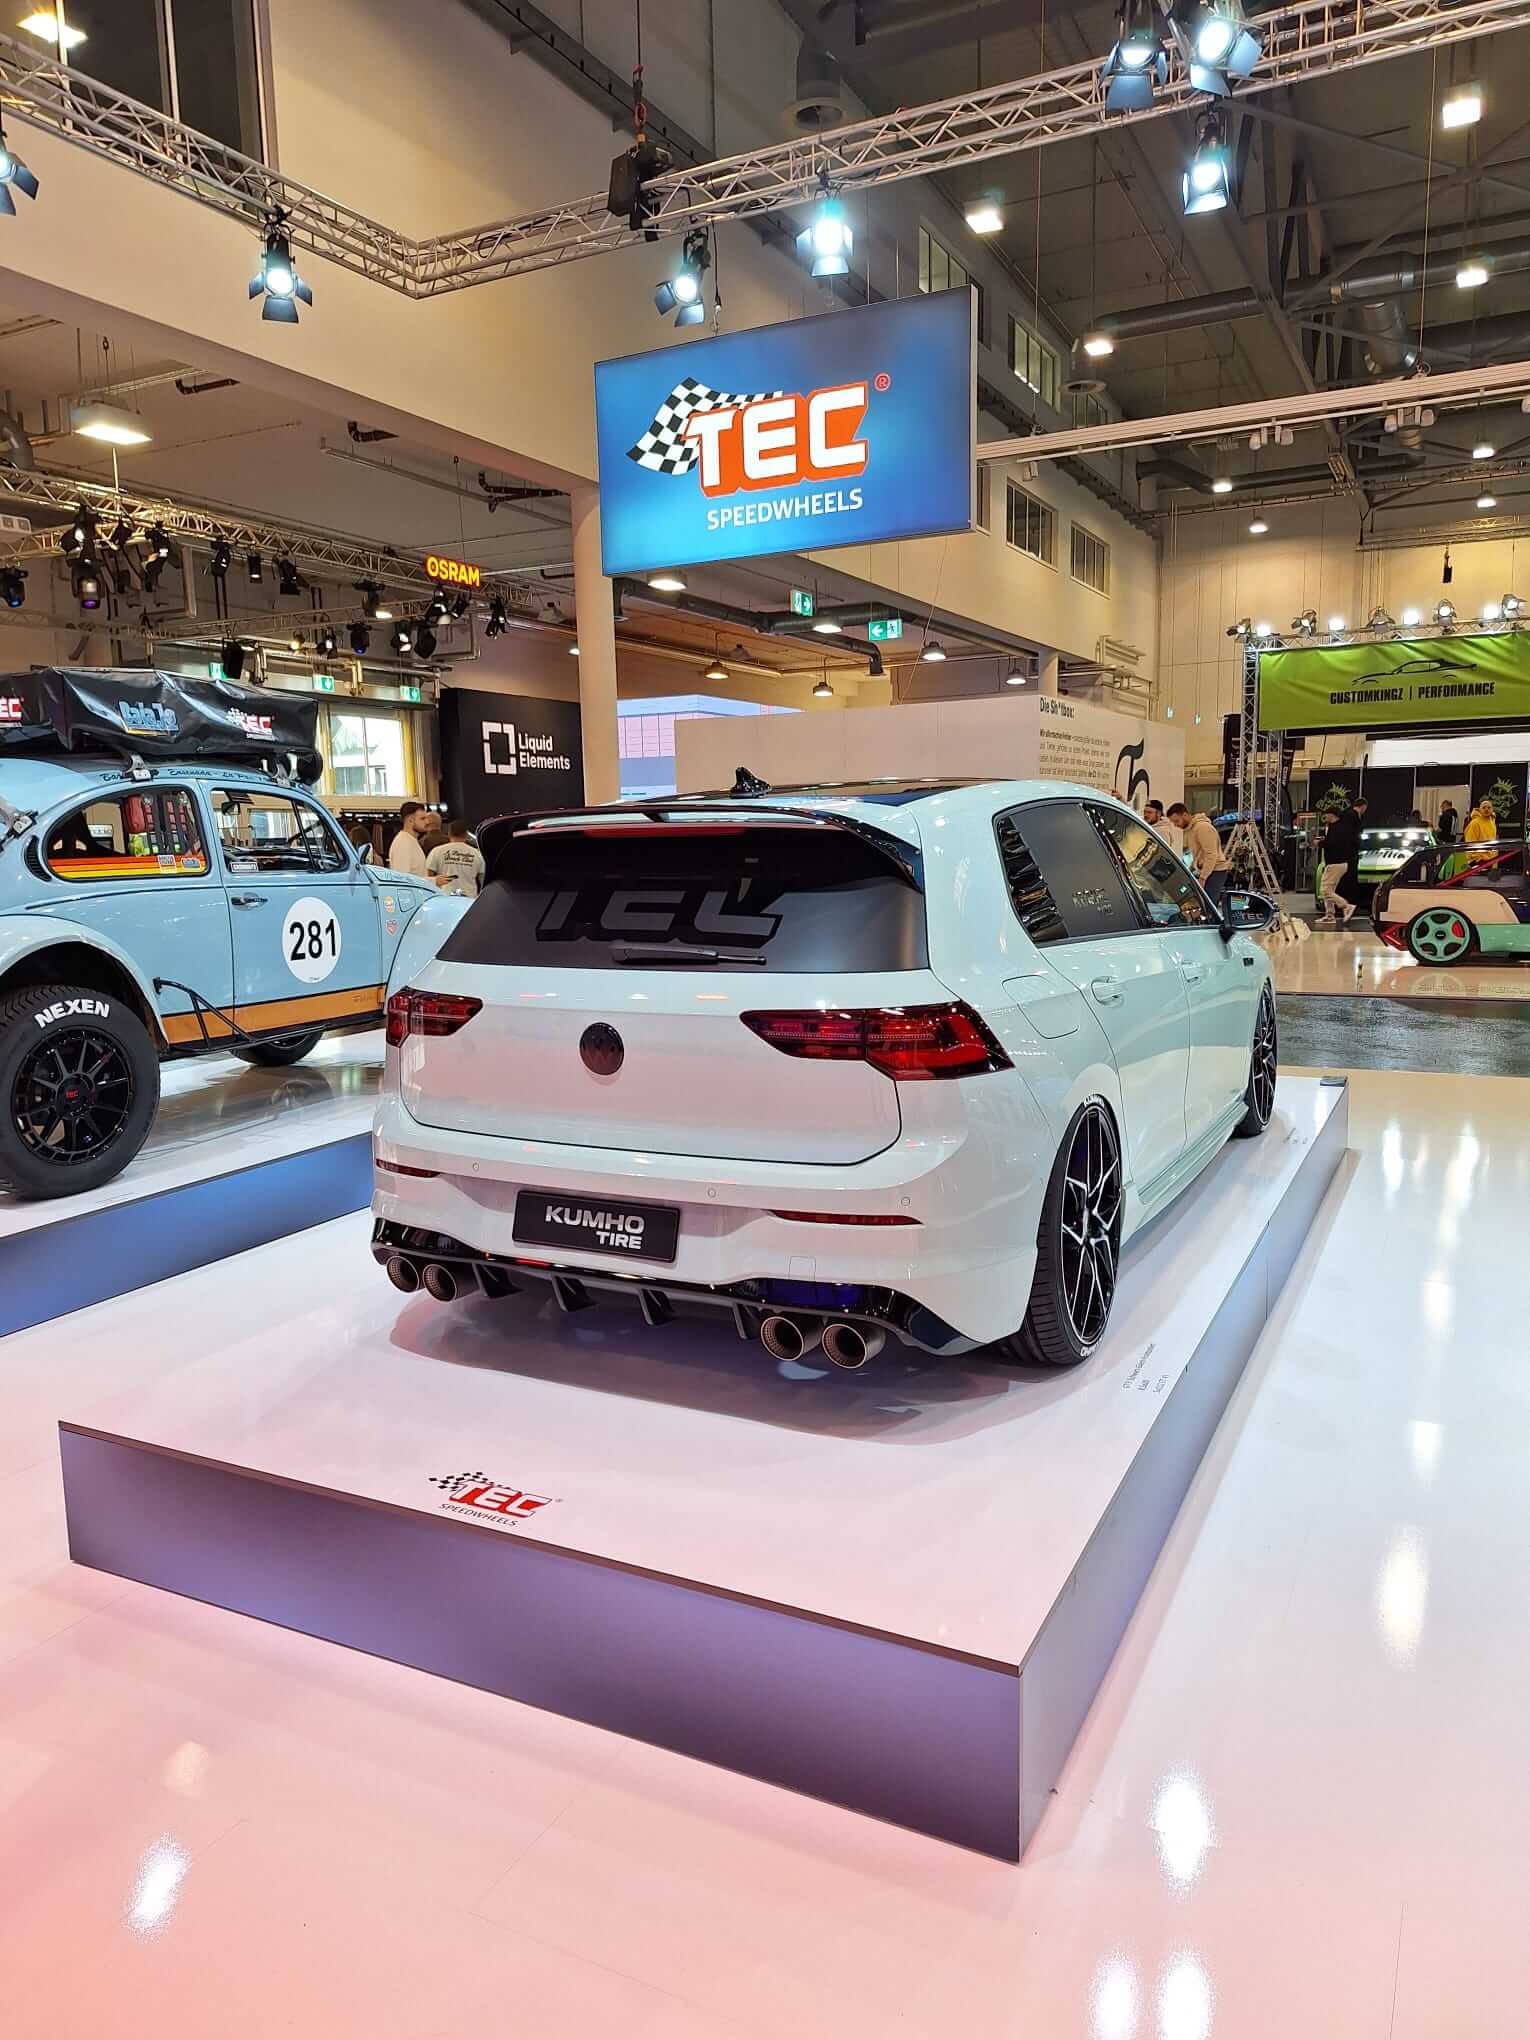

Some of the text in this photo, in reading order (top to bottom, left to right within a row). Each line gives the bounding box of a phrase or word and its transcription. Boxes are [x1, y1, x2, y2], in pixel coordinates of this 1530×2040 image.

[683, 381, 868, 497] TEC
[706, 487, 864, 531] SPEEDWHEELS
[426, 556, 480, 587] OSRAM
[0, 697, 22, 719] EC
[1329, 688, 1404, 705] CUSTOMKINGZ
[1417, 682, 1495, 699] PERFORMANCE
[518, 732, 553, 754] Liquid
[519, 751, 571, 770] Elements
[289, 918, 336, 961] 281
[34, 998, 109, 1028] NEXEN
[545, 1205, 645, 1234] KUMHO
[595, 1230, 643, 1250] TIRE
[448, 1479, 553, 1518] TEC
[438, 1502, 519, 1527] SPEEDWHEELS
